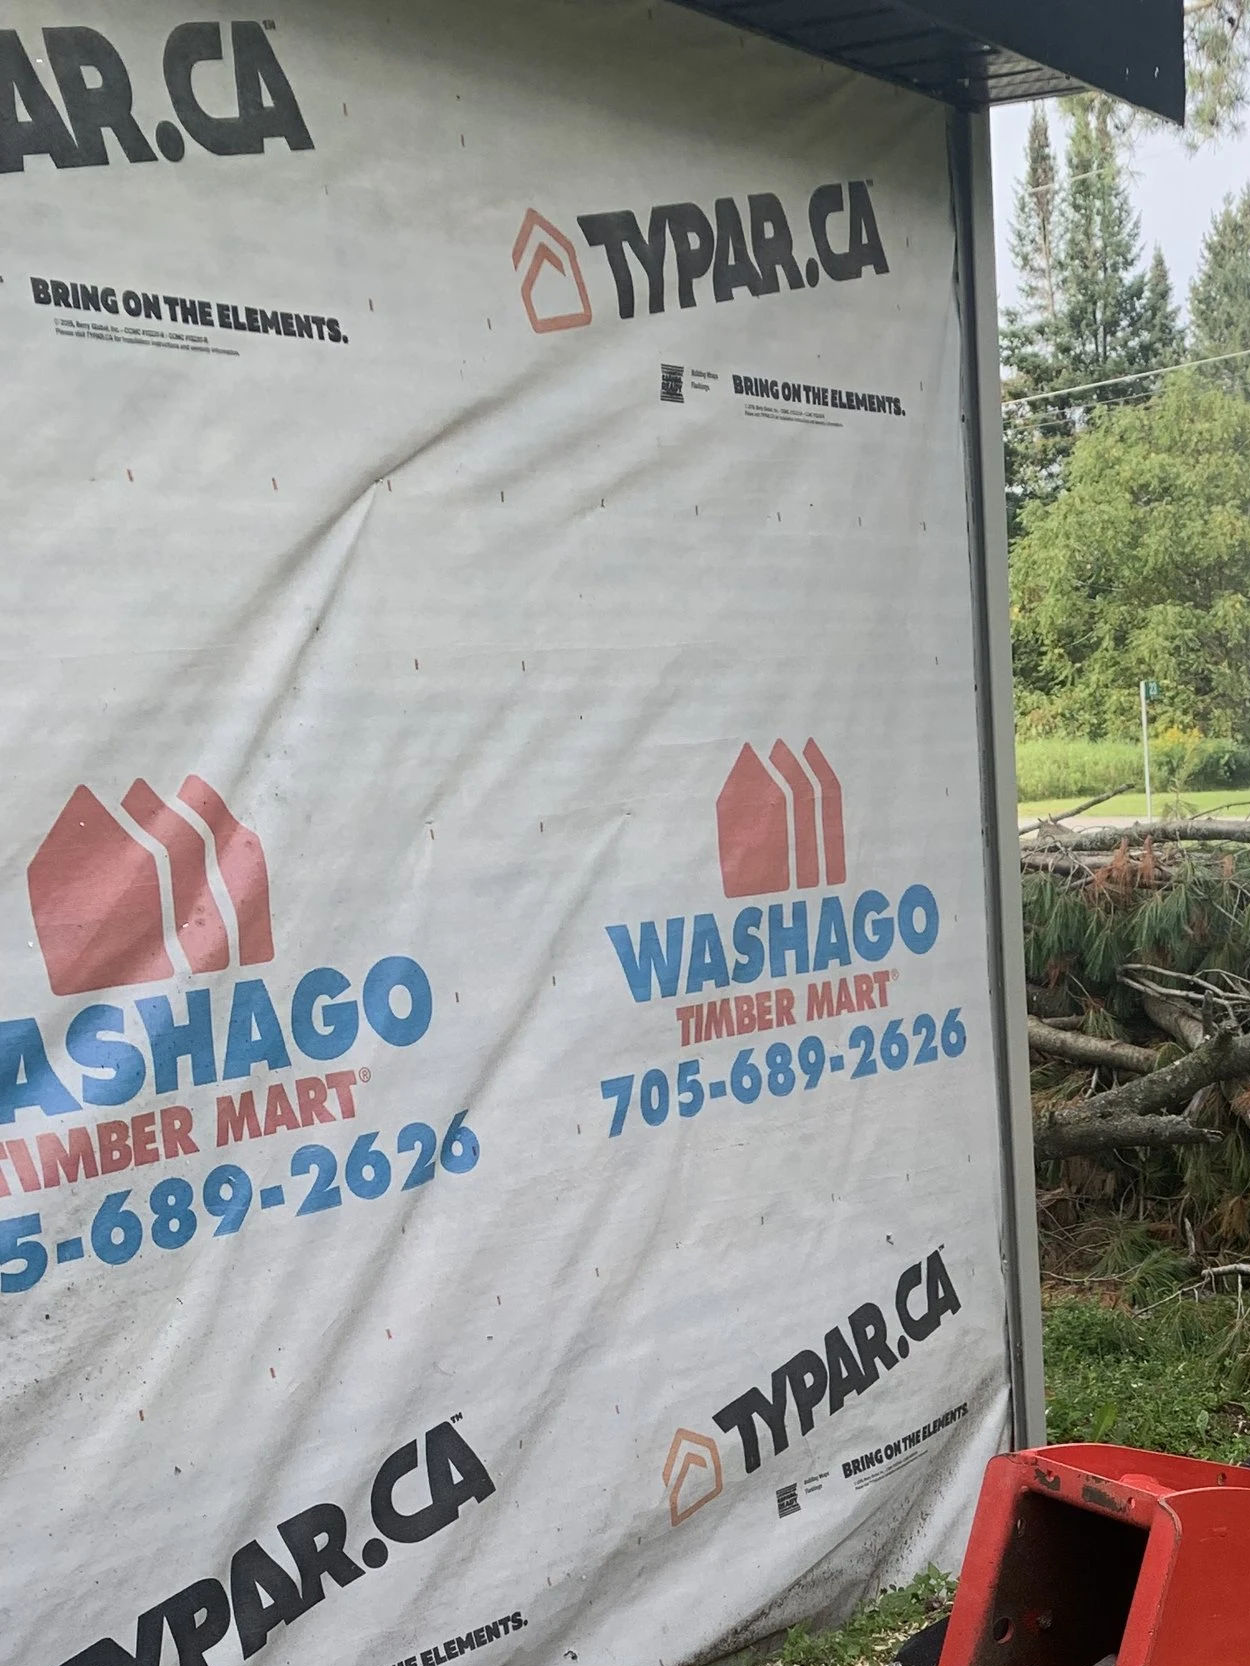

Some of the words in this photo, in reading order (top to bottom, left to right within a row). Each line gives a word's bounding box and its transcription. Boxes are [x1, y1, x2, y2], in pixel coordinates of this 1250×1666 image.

[30, 277, 119, 315] BRING
[122, 290, 162, 320] ON
[163, 295, 214, 327] THE
[216, 302, 349, 344] ELEMENTS.
[732, 374, 779, 400] BRING
[781, 381, 802, 403] ON
[803, 384, 829, 407] THE
[831, 389, 906, 417] ELEMENTS.
[605, 884, 939, 1003] WASHAGO
[676, 988, 796, 1047] TIMBER
[600, 1007, 967, 1138] 705-689-2626
[842, 1448, 884, 1479] BRING
[884, 1440, 902, 1461] ON
[902, 1429, 922, 1452] THE
